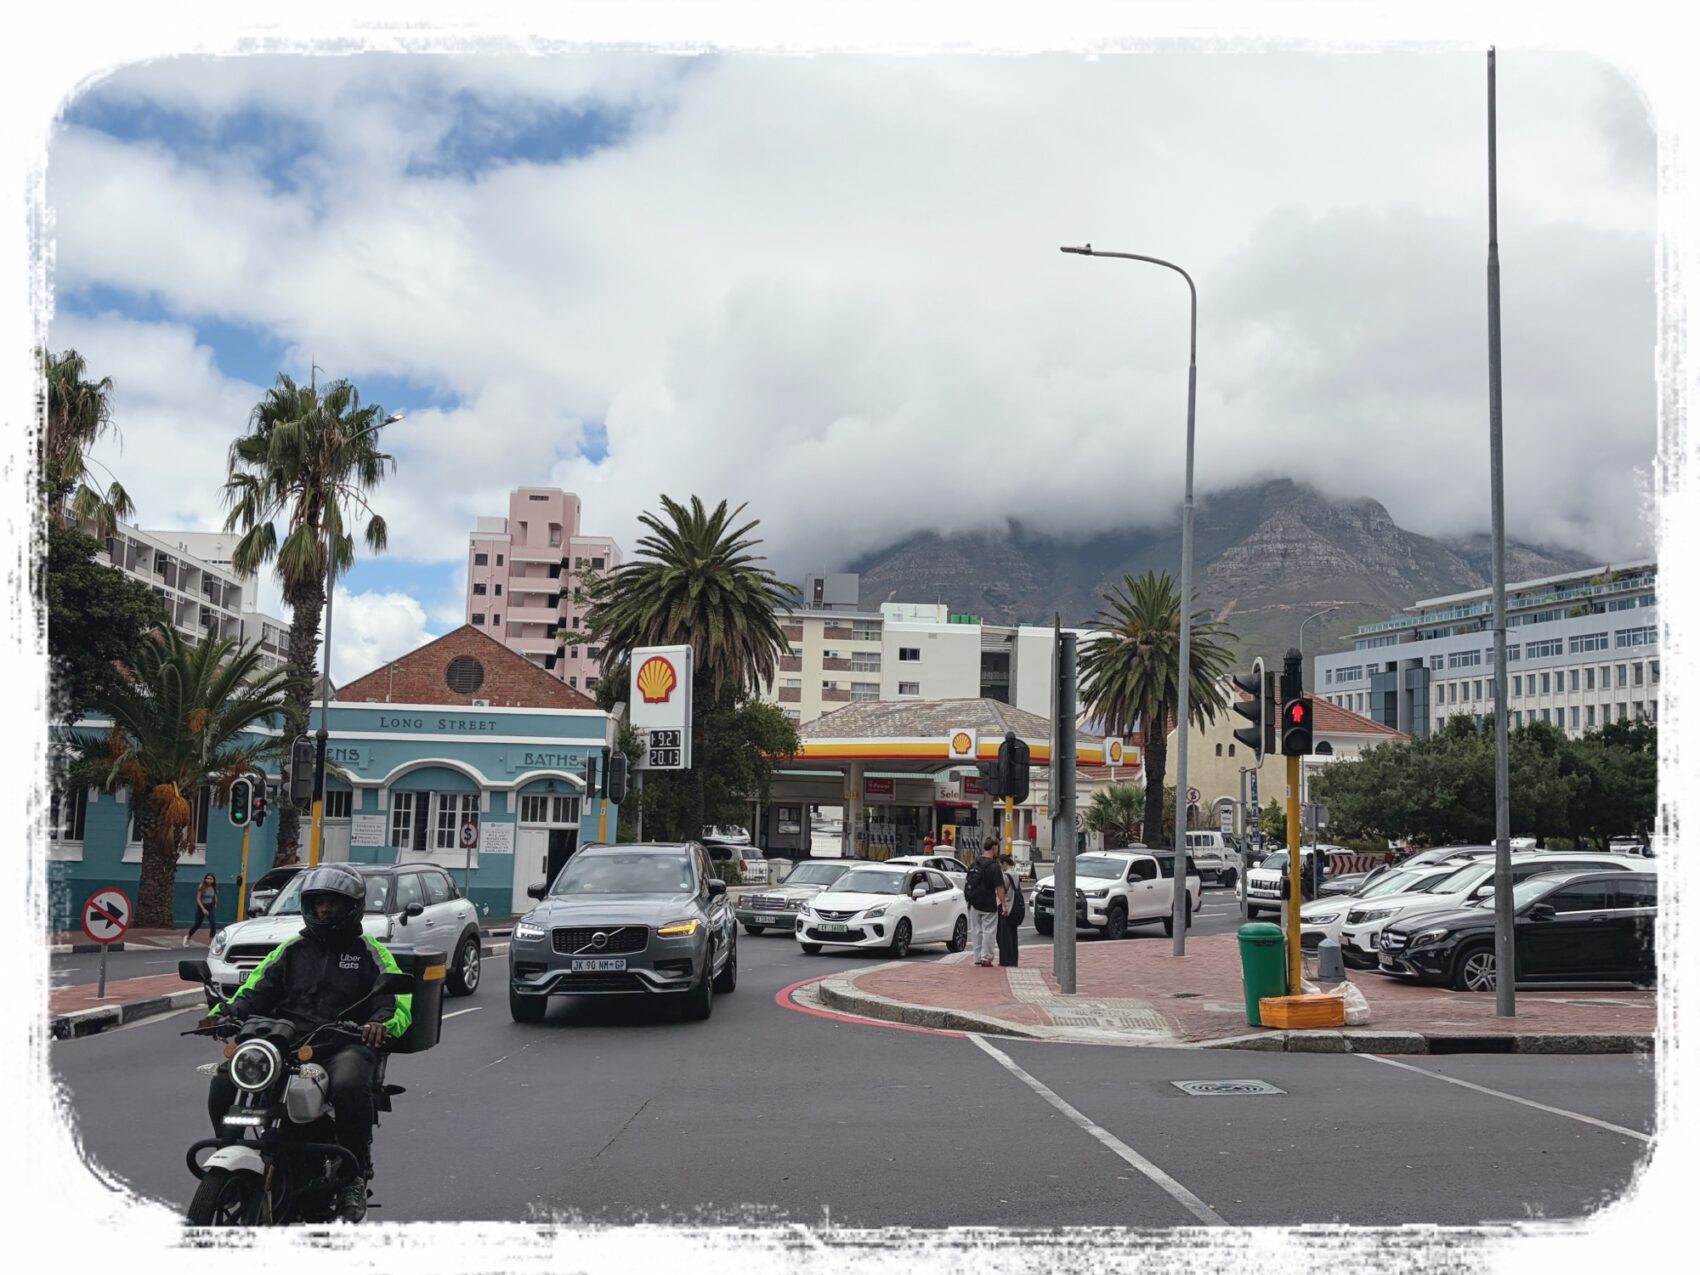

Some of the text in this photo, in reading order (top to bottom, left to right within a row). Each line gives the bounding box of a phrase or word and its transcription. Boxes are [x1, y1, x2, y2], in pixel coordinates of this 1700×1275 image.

[438, 719, 497, 731] STREET
[326, 748, 360, 761] ENS
[524, 752, 580, 767] BATHS
[650, 750, 679, 765] 20.13
[940, 789, 959, 799] Sele
[340, 953, 360, 961] Uber
[339, 961, 359, 969] Eats
[573, 961, 583, 970] JK
[586, 961, 595, 970] 90
[615, 961, 625, 969] GP
